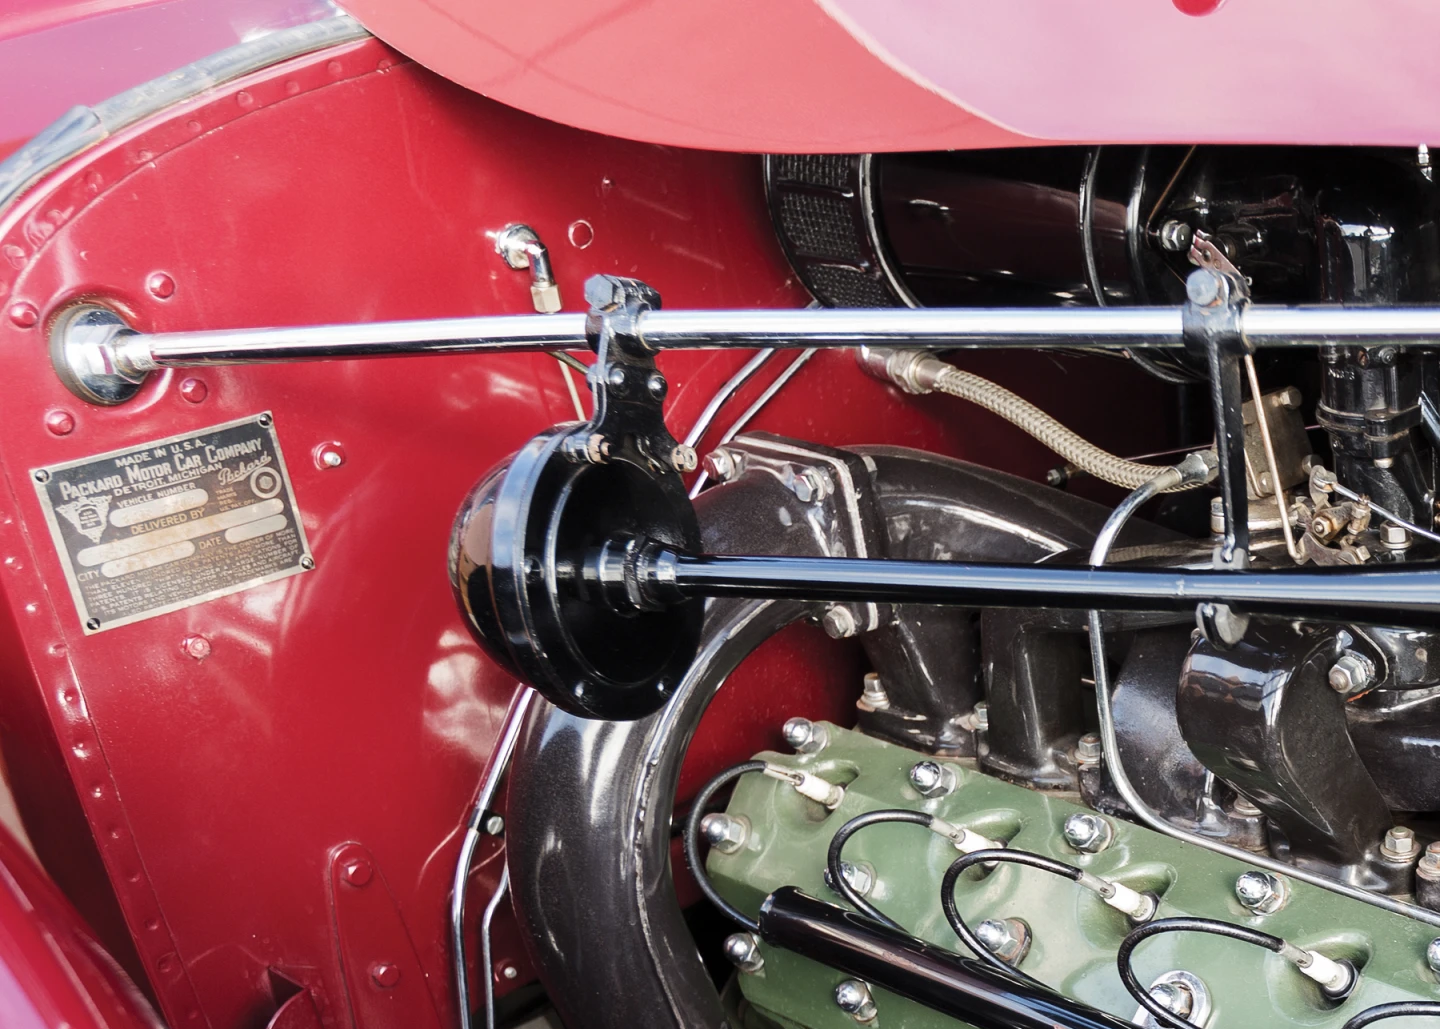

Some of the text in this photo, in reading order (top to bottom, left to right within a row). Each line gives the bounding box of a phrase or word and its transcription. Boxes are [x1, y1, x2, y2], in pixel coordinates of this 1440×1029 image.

[59, 438, 263, 500] PACKARD MOTOR CAR COMPANY
[115, 451, 151, 467] MADE
[154, 447, 166, 457] IN
[217, 451, 271, 485] Packard
[113, 462, 222, 496] DETROIT, MICHIGAN
[117, 493, 152, 508] VEHICLE
[157, 482, 195, 497] NUMBER
[130, 512, 187, 535] DELIVERED
[189, 507, 204, 519] BY
[198, 536, 222, 549] DATE
[77, 569, 100, 581] CITY
